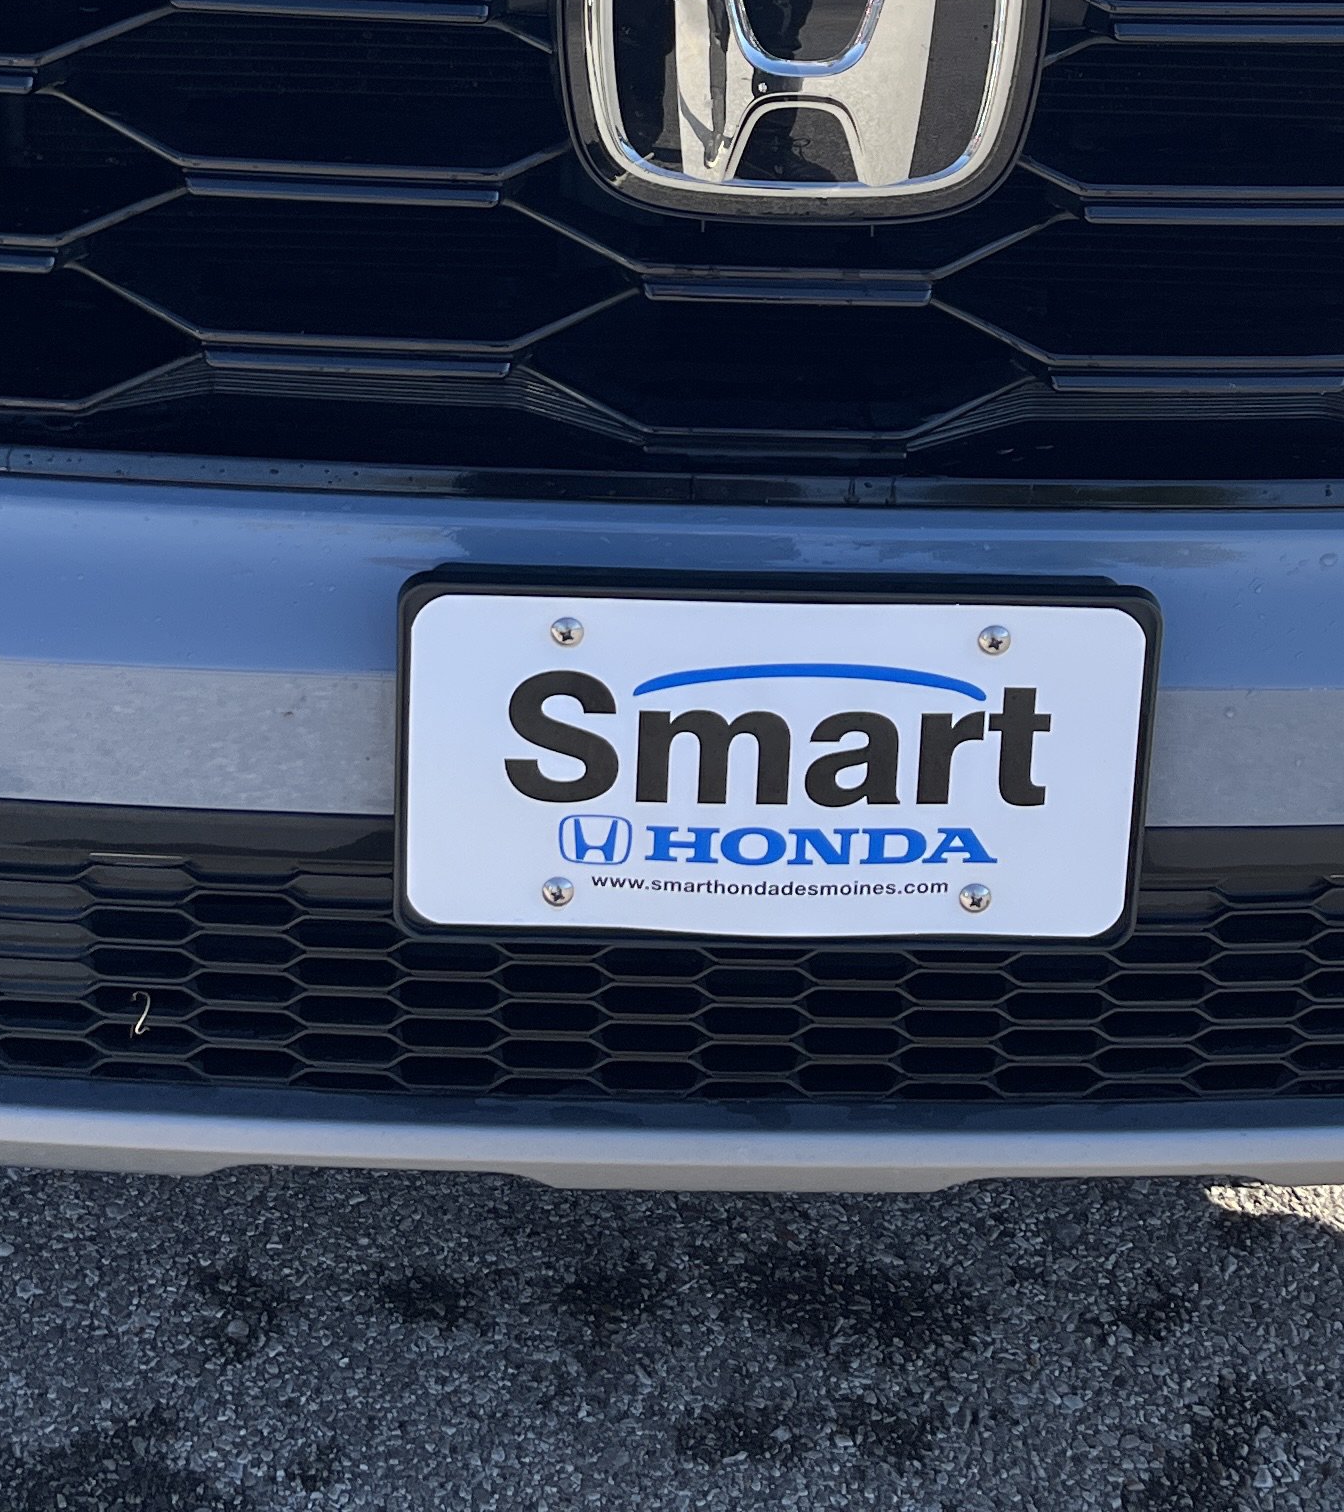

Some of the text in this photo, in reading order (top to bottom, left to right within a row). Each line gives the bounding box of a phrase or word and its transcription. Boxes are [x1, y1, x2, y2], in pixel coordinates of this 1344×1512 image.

[505, 670, 1052, 808] Smart
[646, 825, 999, 867] HONDA
[591, 875, 949, 898] www.smarthondadesmoines.com
